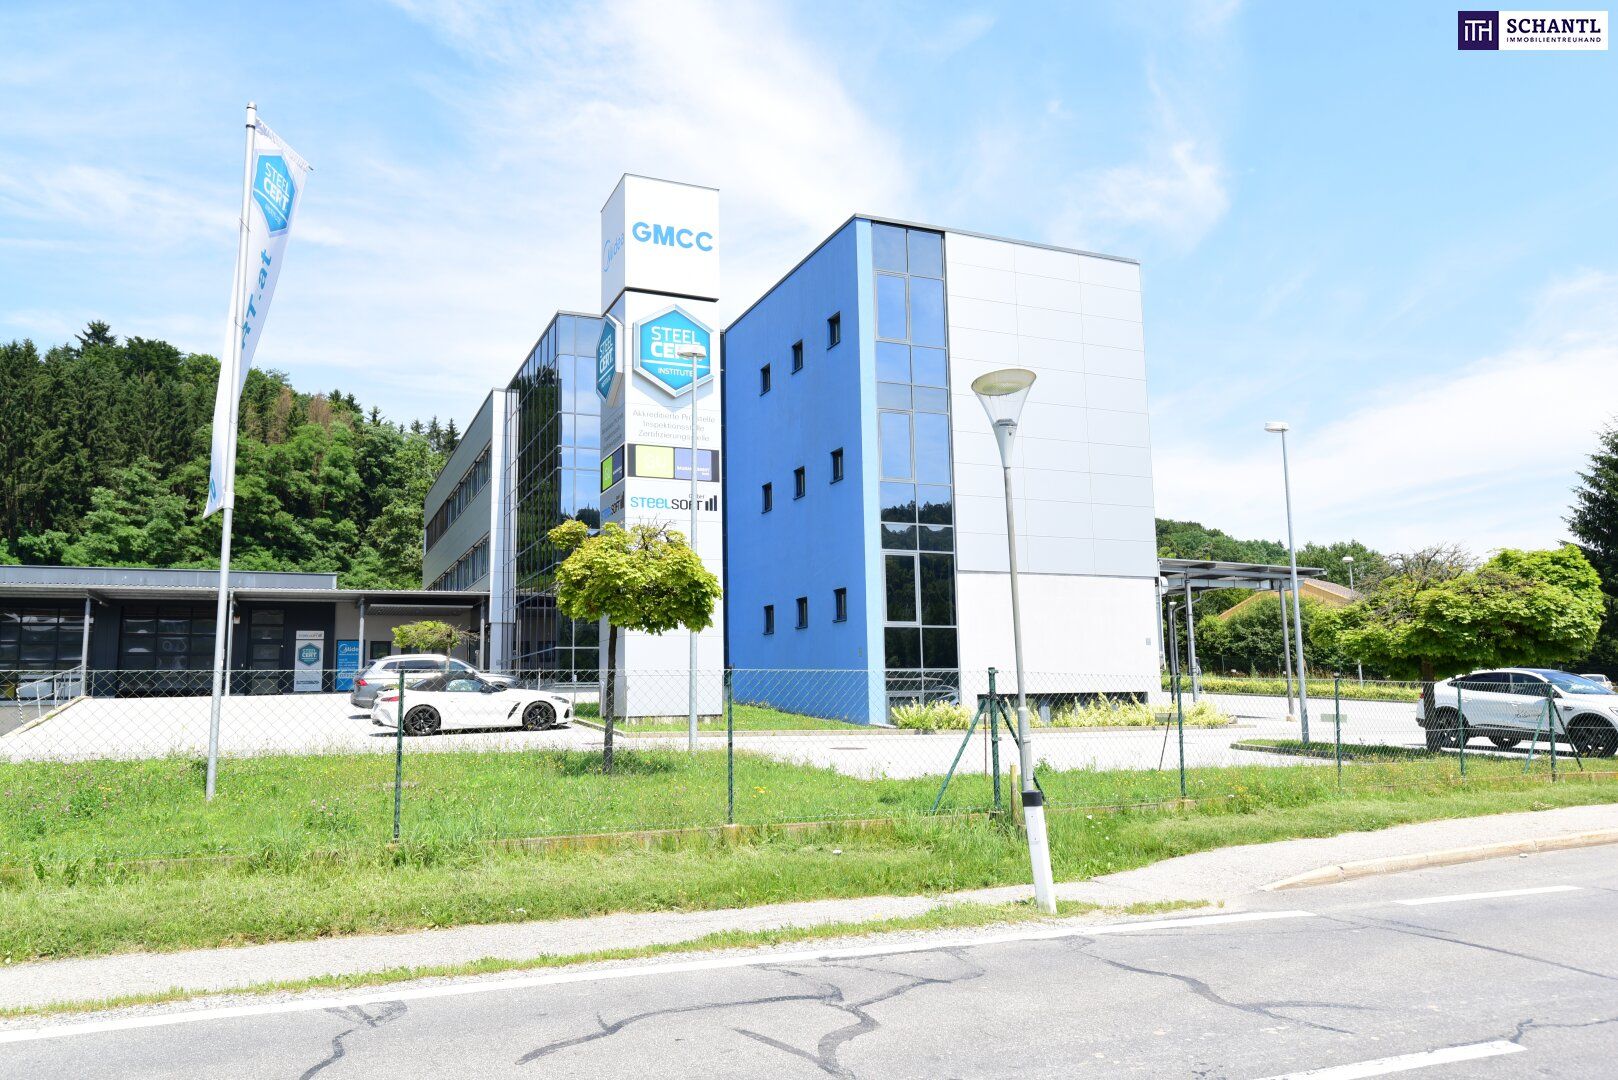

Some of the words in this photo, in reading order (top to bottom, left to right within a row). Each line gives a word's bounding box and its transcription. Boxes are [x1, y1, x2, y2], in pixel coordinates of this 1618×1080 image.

[264, 162, 290, 198] STEEL
[264, 177, 290, 211] CERT
[632, 221, 713, 252] GMCC
[599, 335, 612, 358] STEEL
[651, 326, 700, 345] STEEL
[650, 341, 706, 362] CE
[657, 367, 696, 377] INSTITUTE
